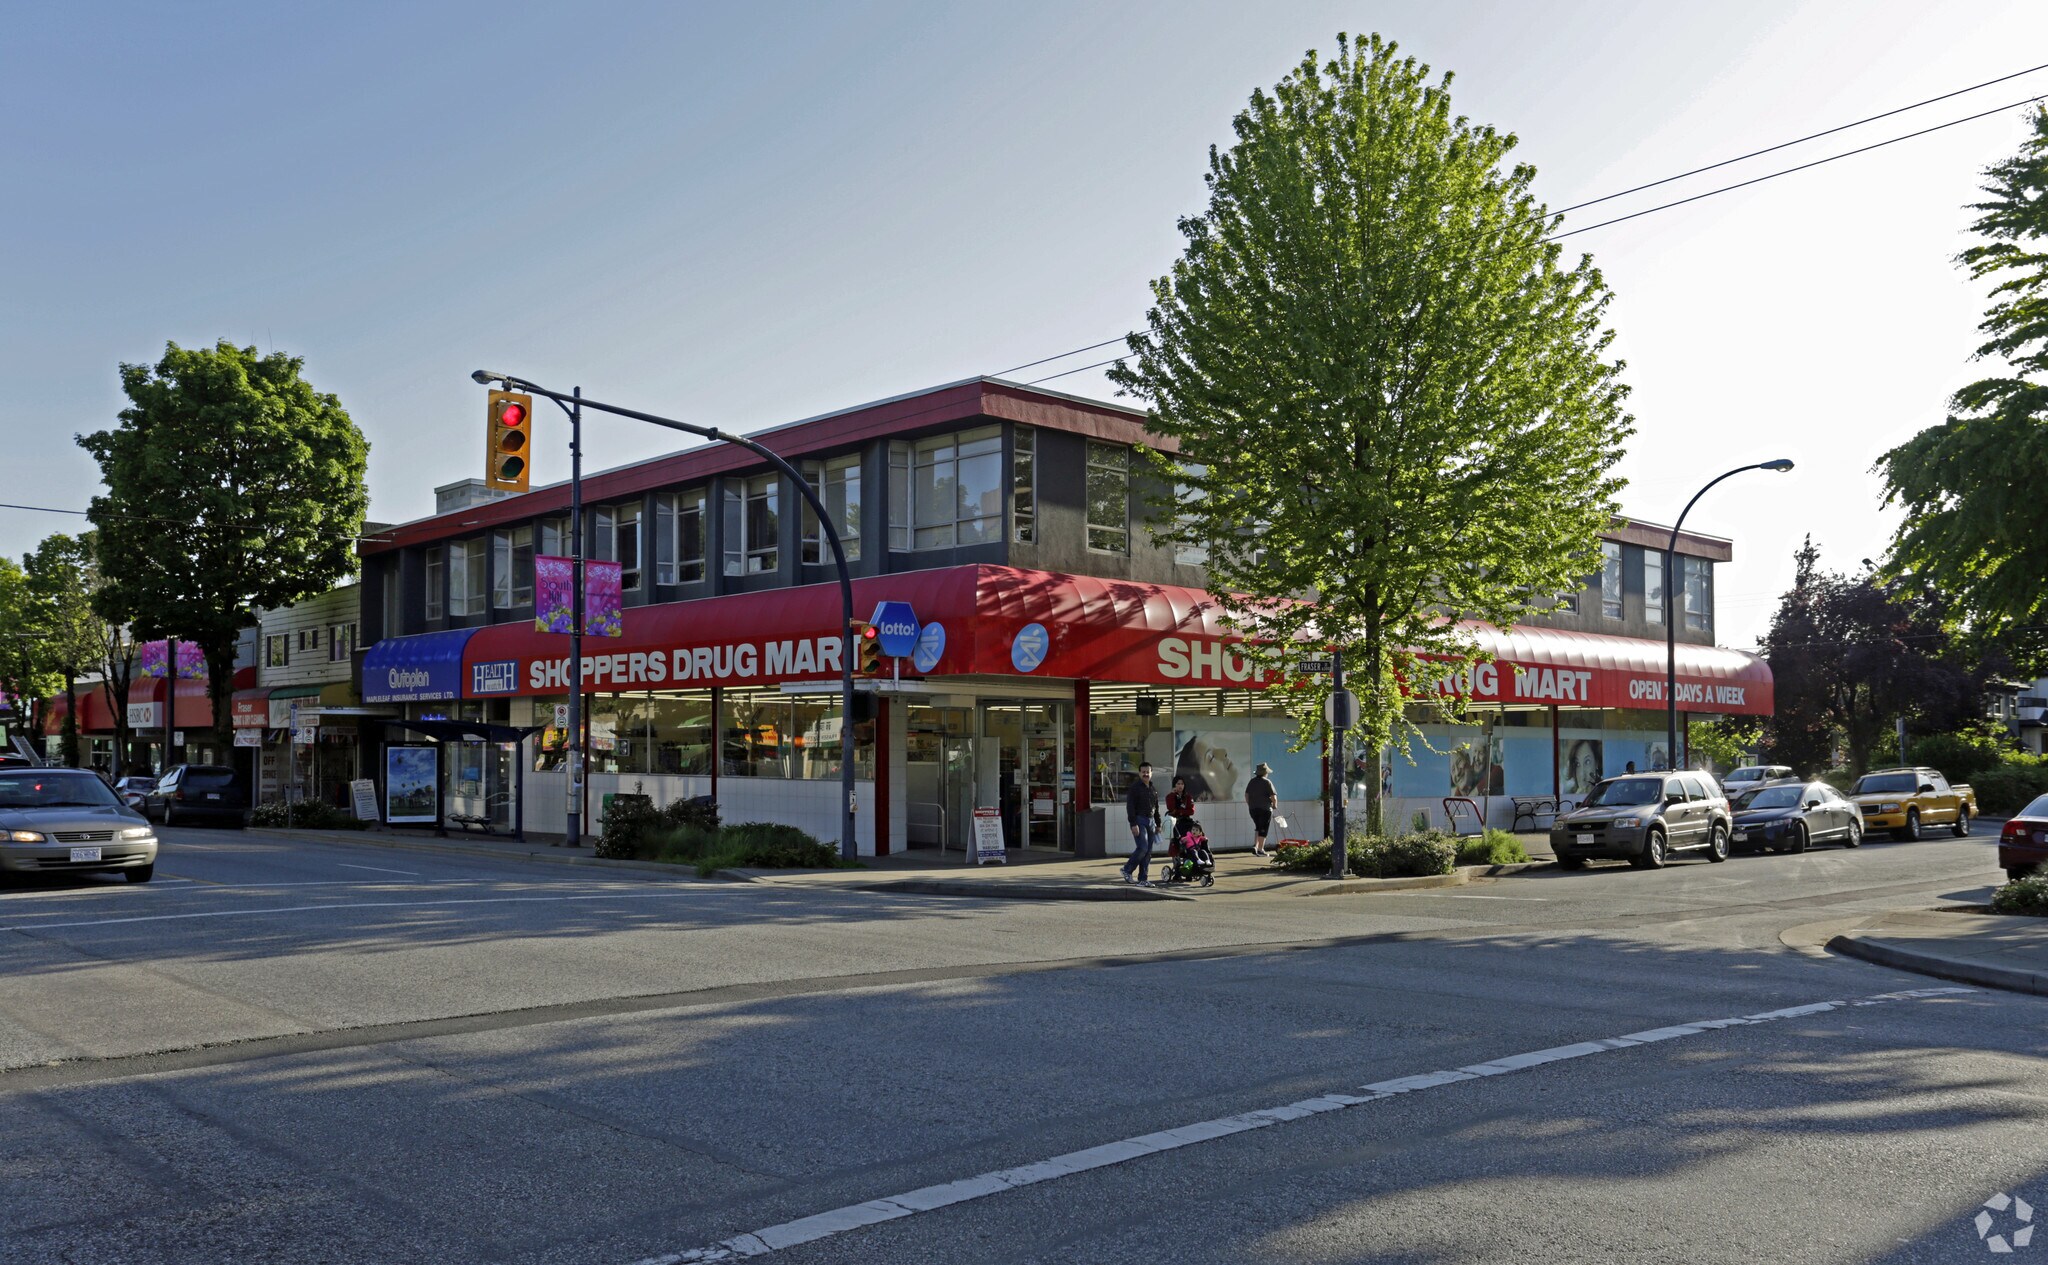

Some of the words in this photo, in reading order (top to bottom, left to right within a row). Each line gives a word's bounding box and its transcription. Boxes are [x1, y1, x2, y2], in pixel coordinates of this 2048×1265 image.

[541, 577, 572, 592] South
[881, 621, 915, 636] lotto!
[529, 649, 667, 689] SHOPPERS
[672, 643, 757, 681] DRUG
[1301, 662, 1321, 671] FRASER
[473, 662, 516, 693] HEALTH
[1515, 666, 1591, 701] MART
[366, 695, 390, 703] MAPLELEAF
[392, 693, 417, 702] INSURANCE
[419, 692, 442, 701] SERVICES
[443, 691, 455, 699] LTD.
[1629, 679, 1662, 700] OPEN
[1674, 683, 1703, 703] DAYS
[1705, 685, 1714, 704] A
[1716, 686, 1745, 705] WEEK
[237, 702, 253, 713] Fraser
[129, 707, 144, 724] HSBC
[264, 756, 275, 765] OFF
